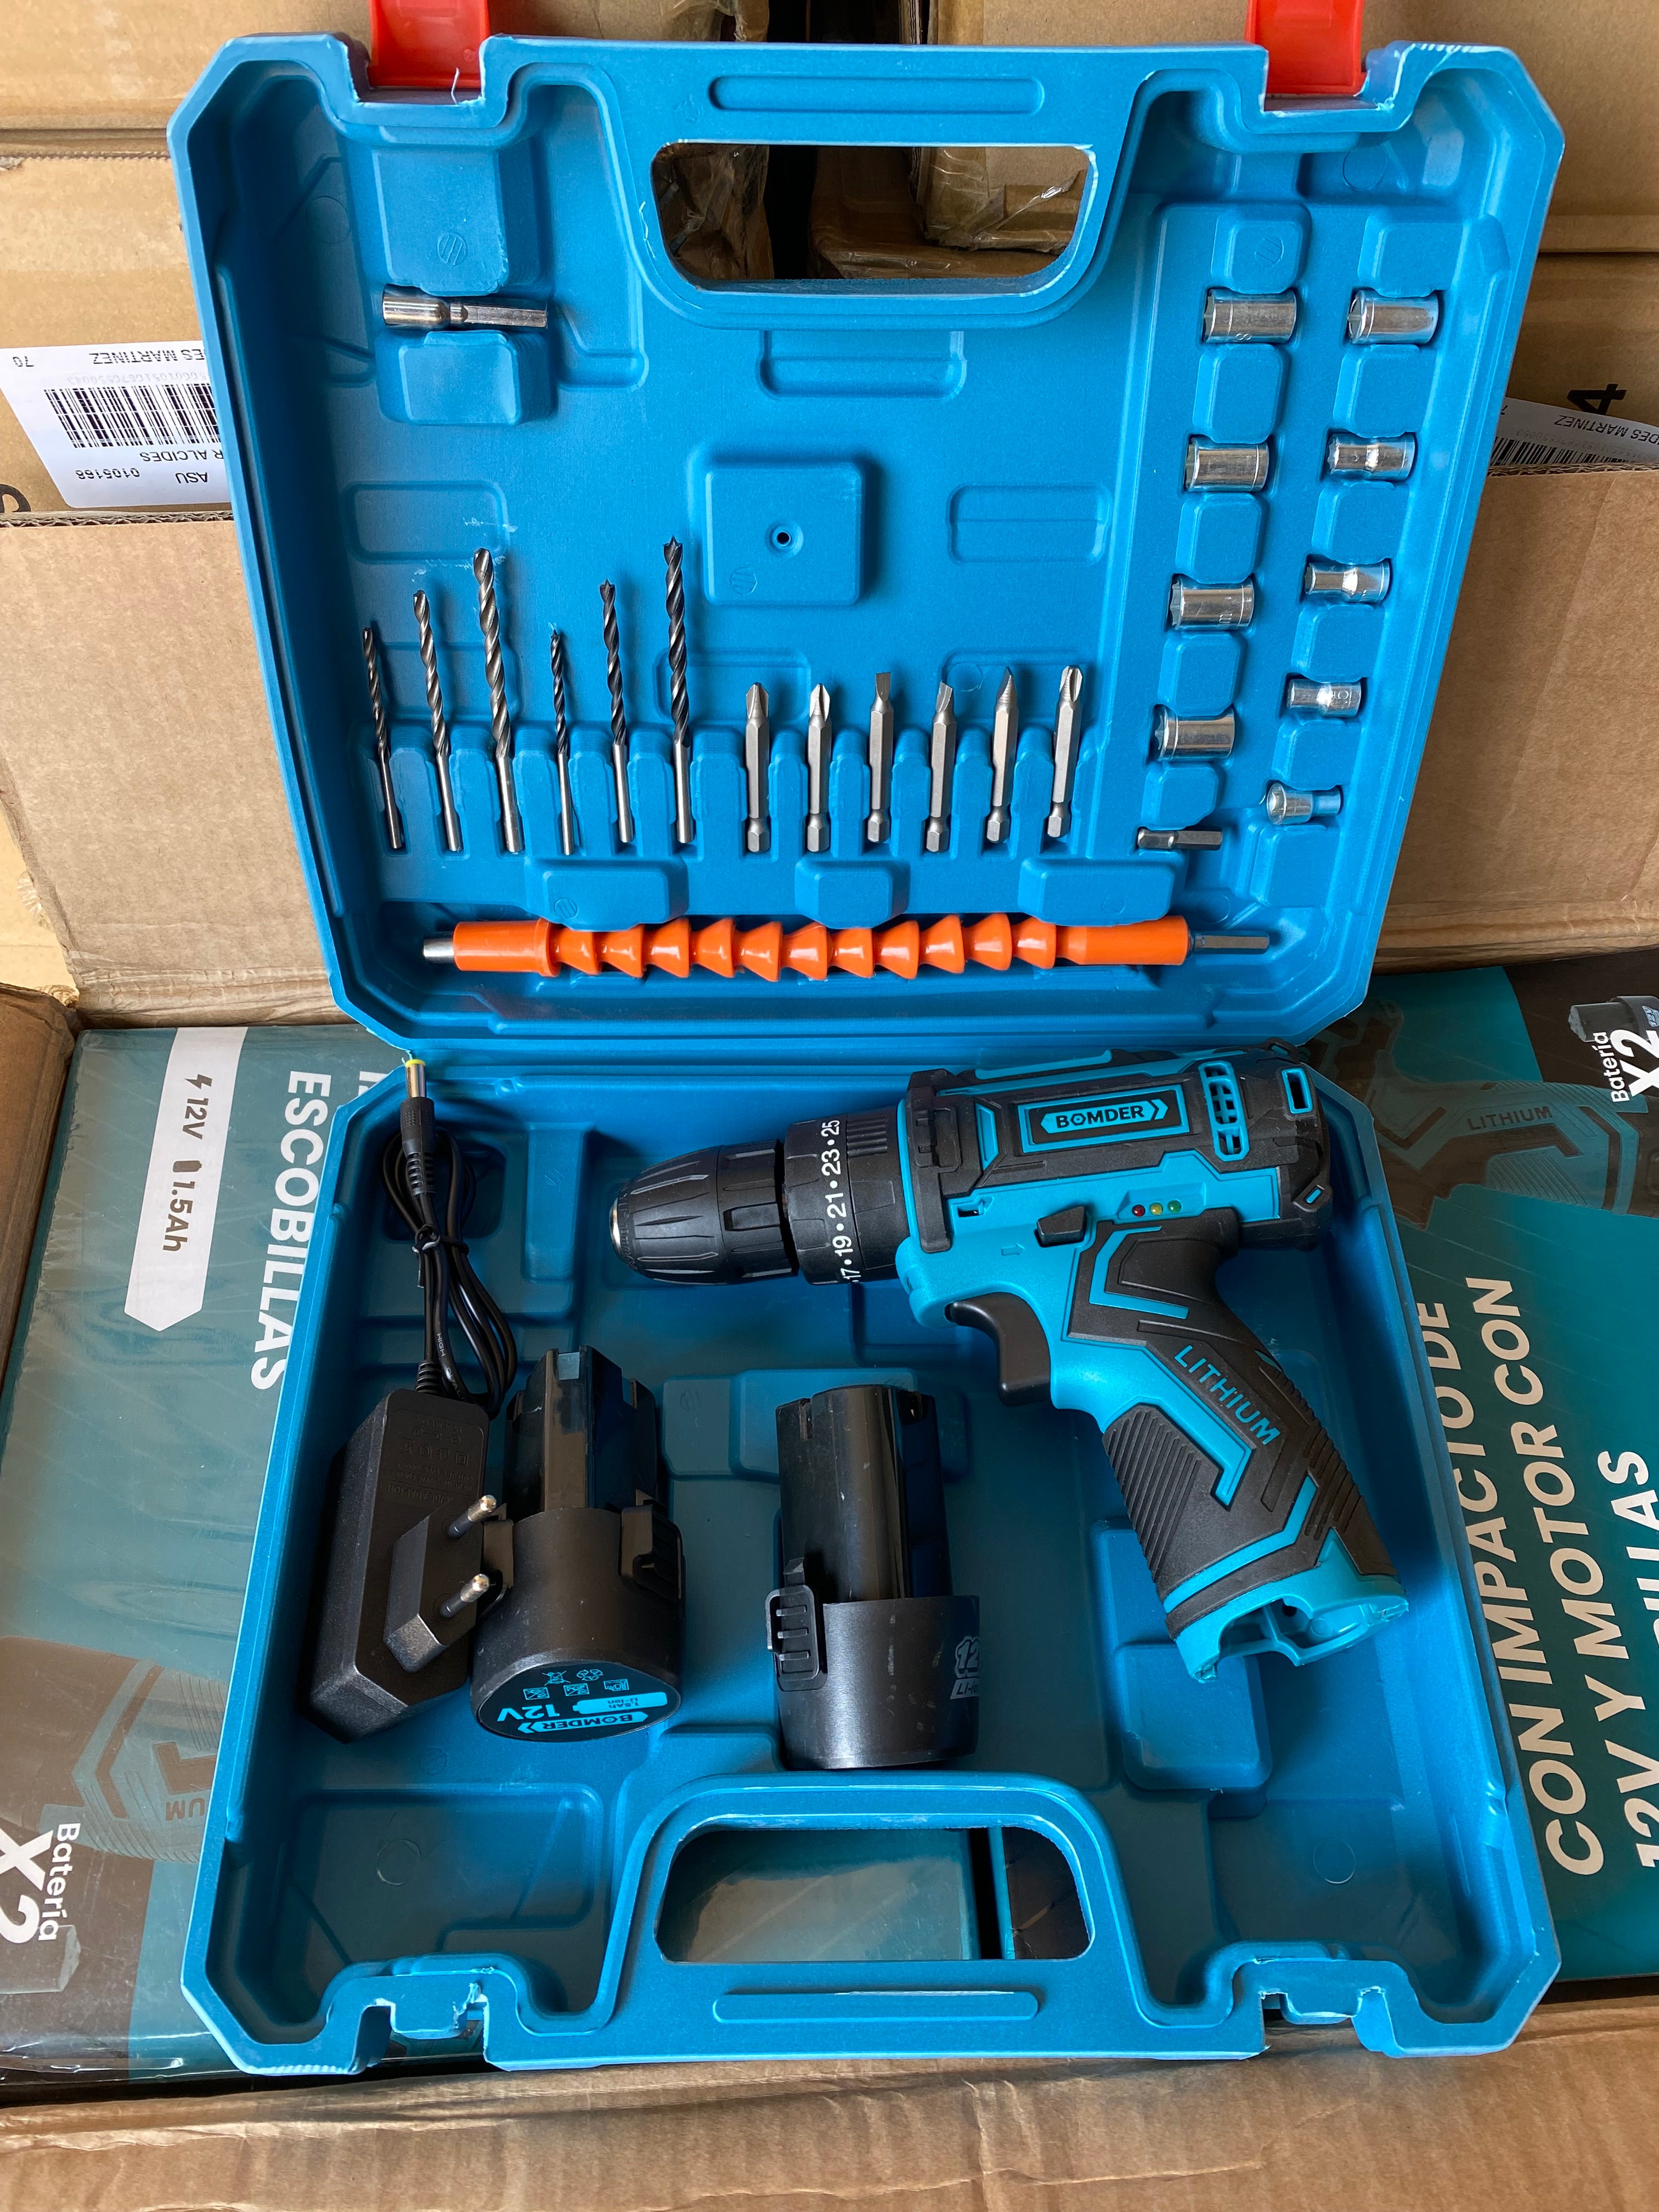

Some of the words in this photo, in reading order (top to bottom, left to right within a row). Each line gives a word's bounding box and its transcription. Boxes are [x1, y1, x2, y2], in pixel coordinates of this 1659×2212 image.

[12, 355, 35, 367] 70
[88, 349, 178, 365] MARTINEZ
[180, 348, 205, 360] ES
[1554, 415, 1629, 438] MARTINEZ
[139, 449, 208, 462] ALCIDES
[75, 466, 140, 480] 0105168
[175, 471, 208, 483] ASU
[1592, 1032, 1629, 1102] Batería
[182, 1097, 209, 1140] 12V
[821, 1119, 840, 1137] 25
[1056, 1105, 1144, 1128] BOMDER
[1467, 1106, 1553, 1131] LITHIUM
[821, 1149, 841, 1177] 23
[162, 1180, 196, 1252] 1.5Ah
[826, 1192, 848, 1218] 21
[251, 1070, 331, 1390] ESCOBILLAS
[833, 1235, 854, 1257] 19
[1466, 1277, 1544, 1406] CON
[1175, 1345, 1280, 1445] LITHIUM
[1510, 1421, 1630, 1660] MOTOR
[1584, 1674, 1646, 1722] Y
[496, 1704, 560, 1722] 12V
[543, 1714, 633, 1730] BOMDER
[1508, 1703, 1604, 1875] CON
[37, 1822, 81, 1941] Batería
